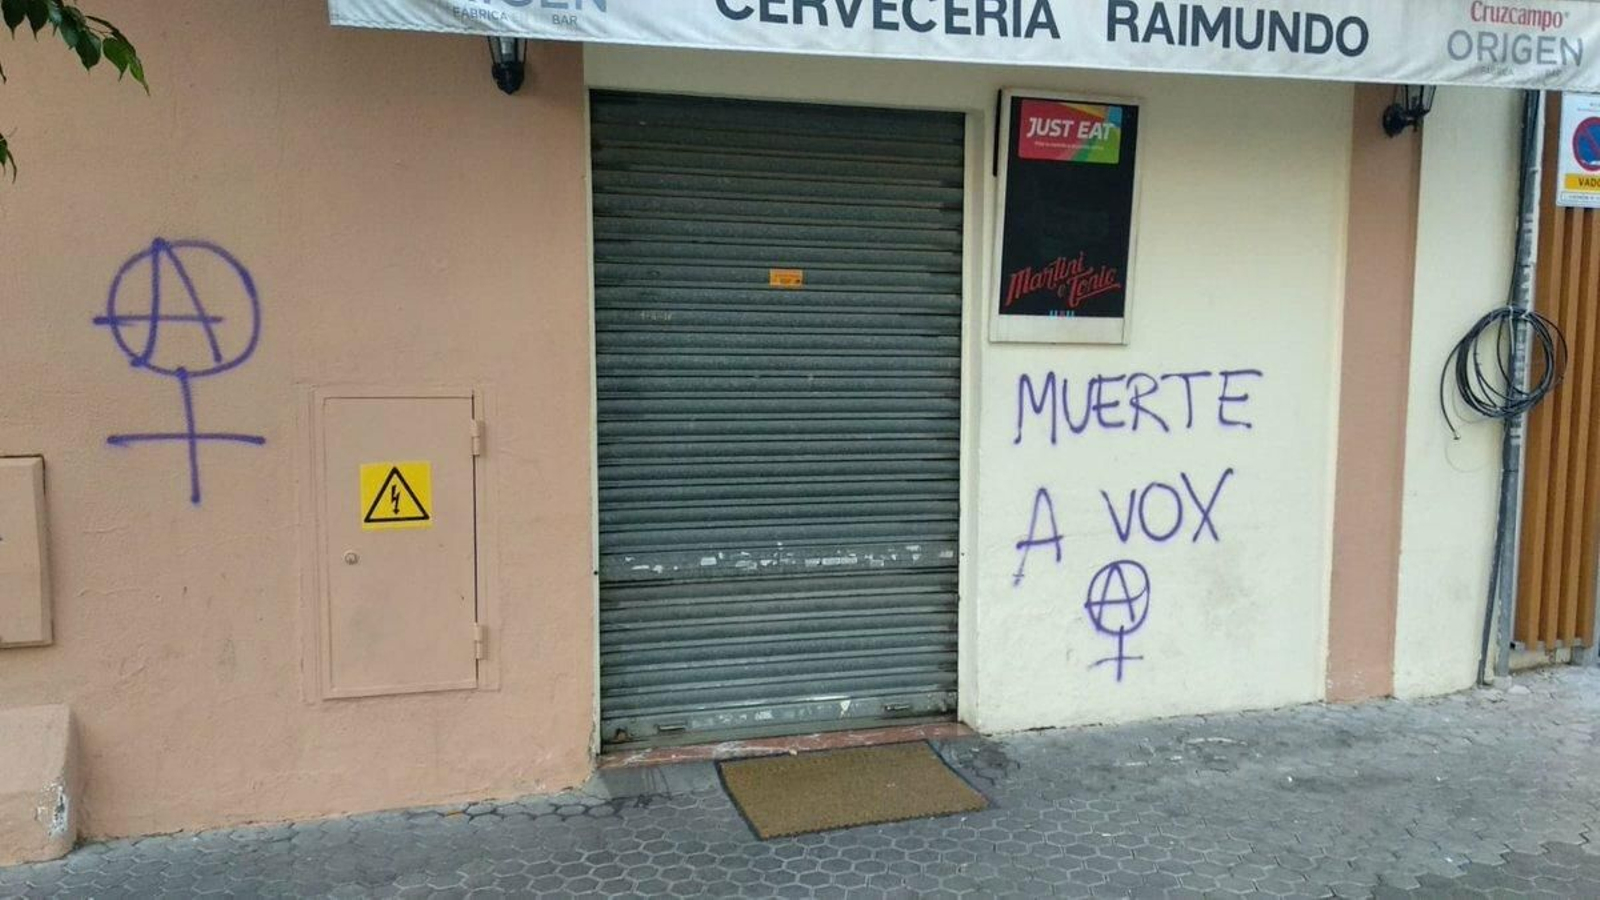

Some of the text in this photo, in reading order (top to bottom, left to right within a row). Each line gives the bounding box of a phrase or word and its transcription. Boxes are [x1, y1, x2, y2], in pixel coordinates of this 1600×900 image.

[552, 14, 578, 26] BAR
[1106, 0, 1369, 57] RAIMUNDO
[1470, 0, 1563, 31] Cruzcampo
[1447, 29, 1584, 66] ORIGEN
[1026, 117, 1116, 140] JUST EAT
[1004, 251, 1086, 306] Martini
[1066, 265, 1121, 308] Tonic
[1013, 369, 1263, 445] MUERTE
[1013, 467, 1234, 587] A VOX
